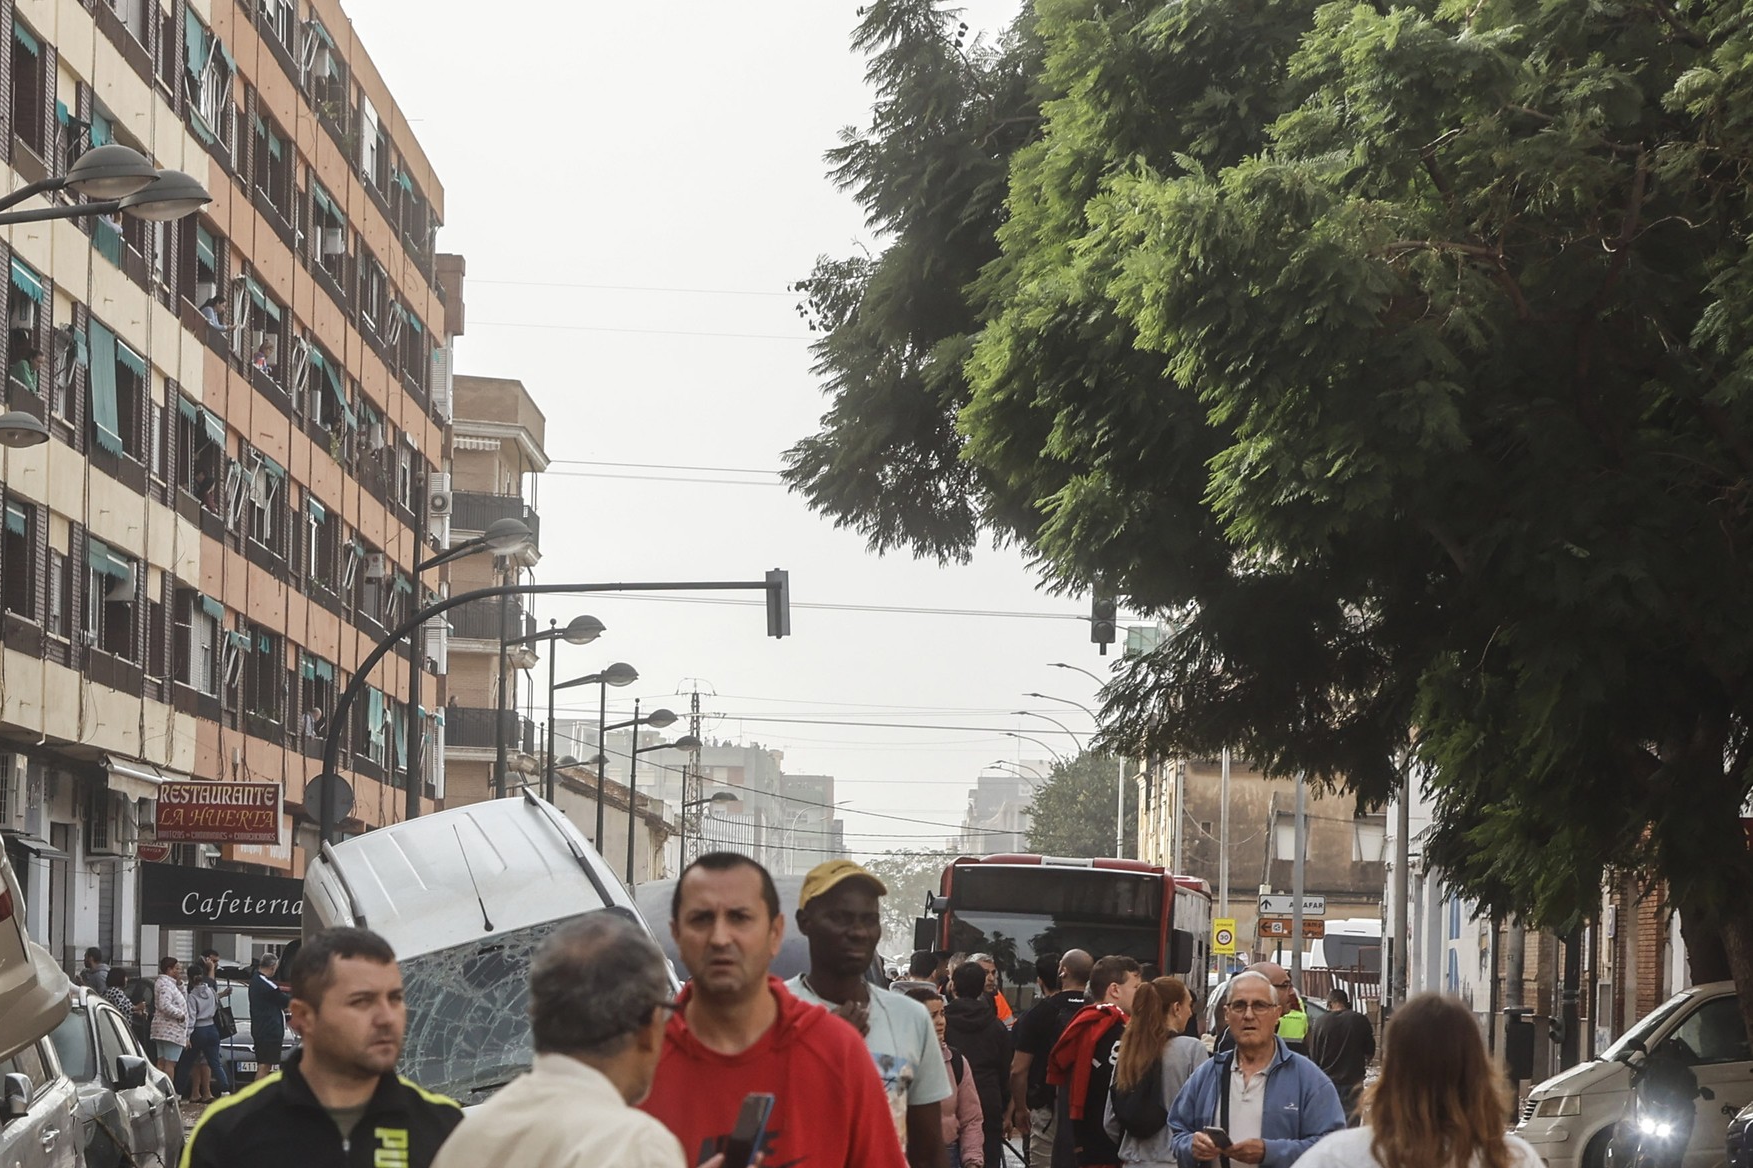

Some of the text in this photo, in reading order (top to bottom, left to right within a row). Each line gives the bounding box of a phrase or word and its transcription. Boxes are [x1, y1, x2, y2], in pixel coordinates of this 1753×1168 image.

[159, 784, 275, 806] RESTAURANTE
[159, 807, 275, 831] LA HUERTA
